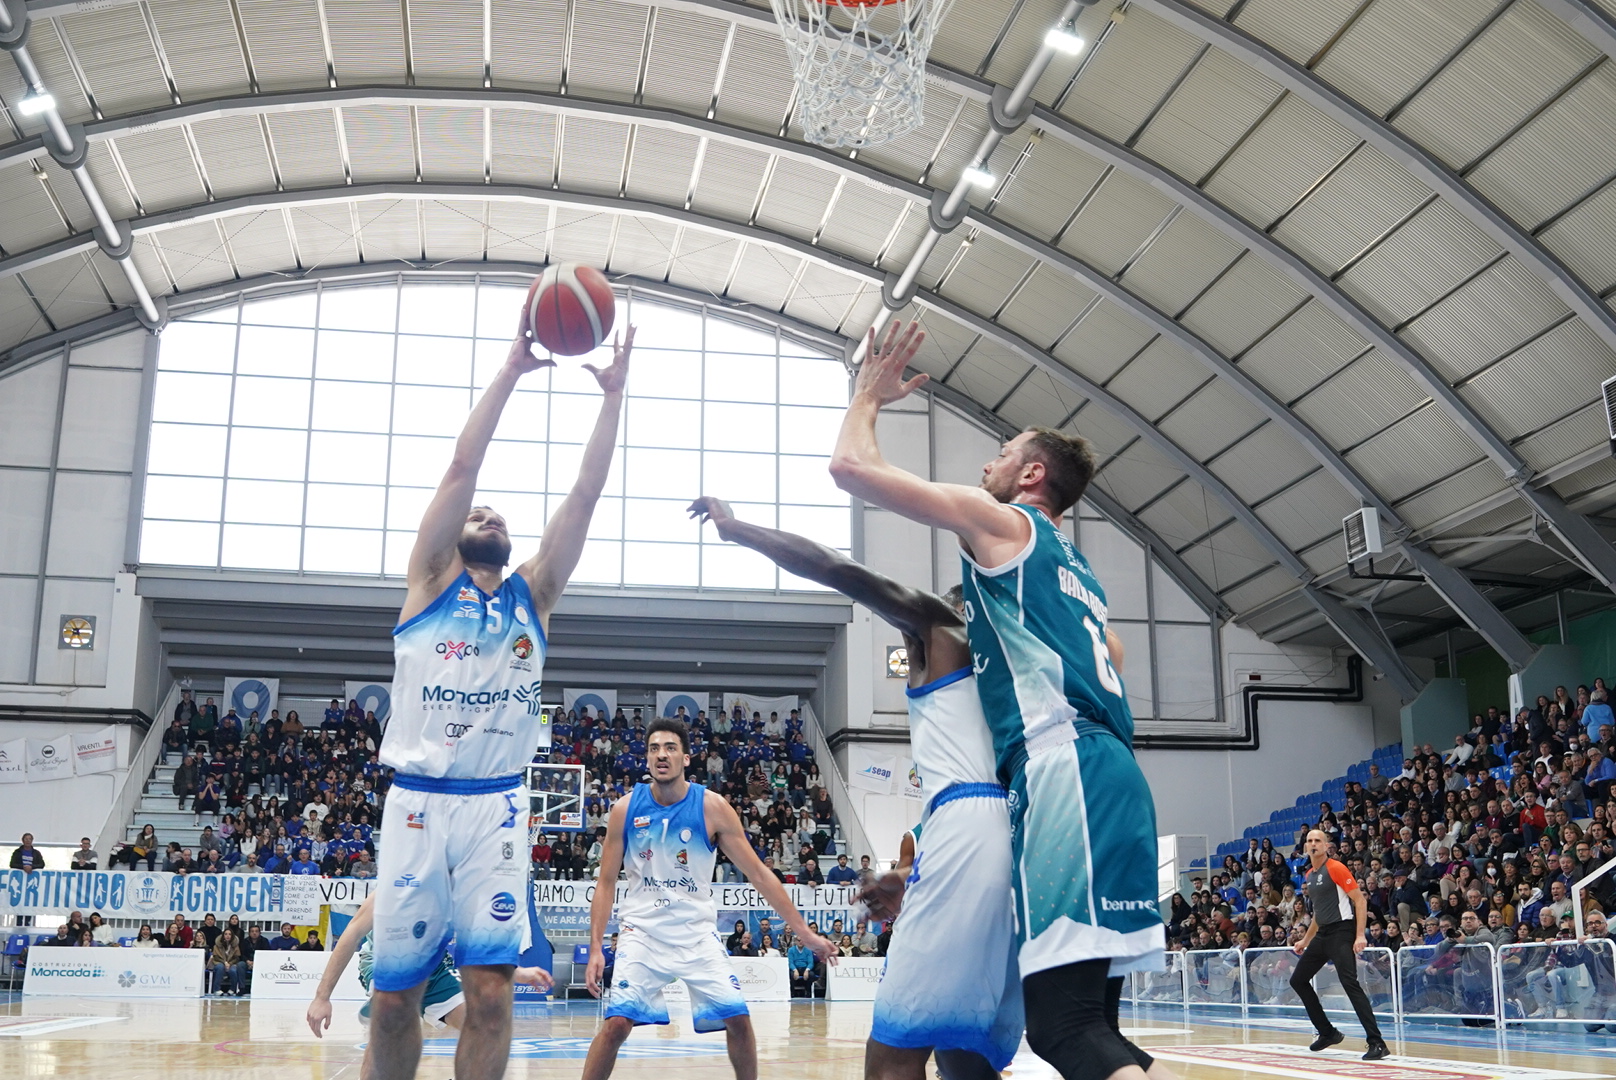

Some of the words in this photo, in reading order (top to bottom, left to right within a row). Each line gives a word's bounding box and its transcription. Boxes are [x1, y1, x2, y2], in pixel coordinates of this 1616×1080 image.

[486, 597, 502, 634] 5
[423, 704, 465, 712] ENERY
[872, 766, 891, 779] seap
[662, 818, 668, 843] 1
[0, 869, 125, 910] FORTITUDO
[722, 888, 770, 907] ESSER
[544, 915, 558, 924] WE
[559, 916, 577, 925] ARE
[31, 967, 90, 978] Moncada
[140, 974, 171, 985] GVM
